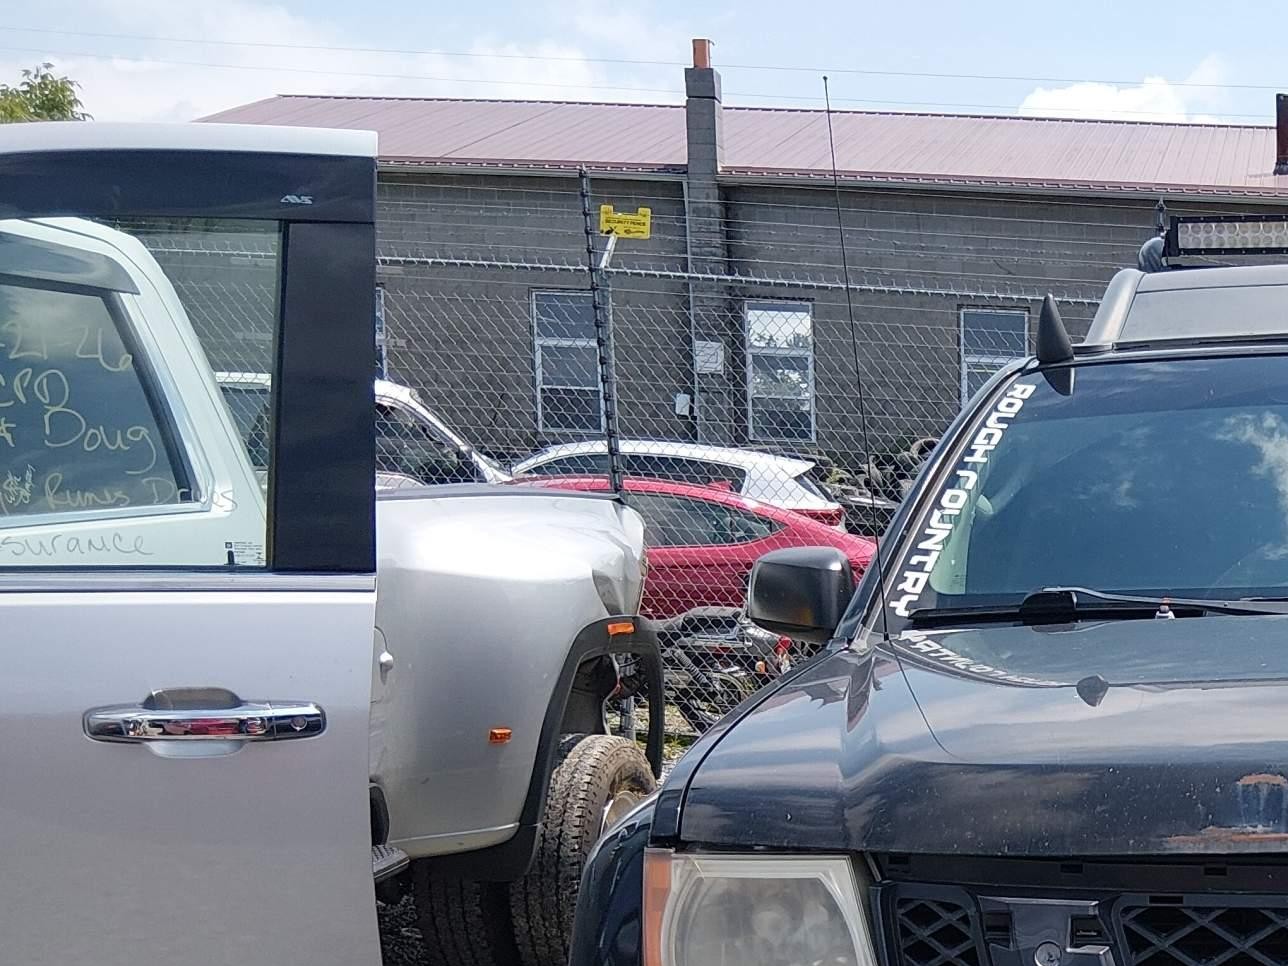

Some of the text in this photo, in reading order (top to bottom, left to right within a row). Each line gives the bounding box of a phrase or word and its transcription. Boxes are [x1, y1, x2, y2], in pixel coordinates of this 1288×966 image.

[43, 407, 157, 475] Doug
[889, 383, 1037, 617] ROUGH COUNTRY
